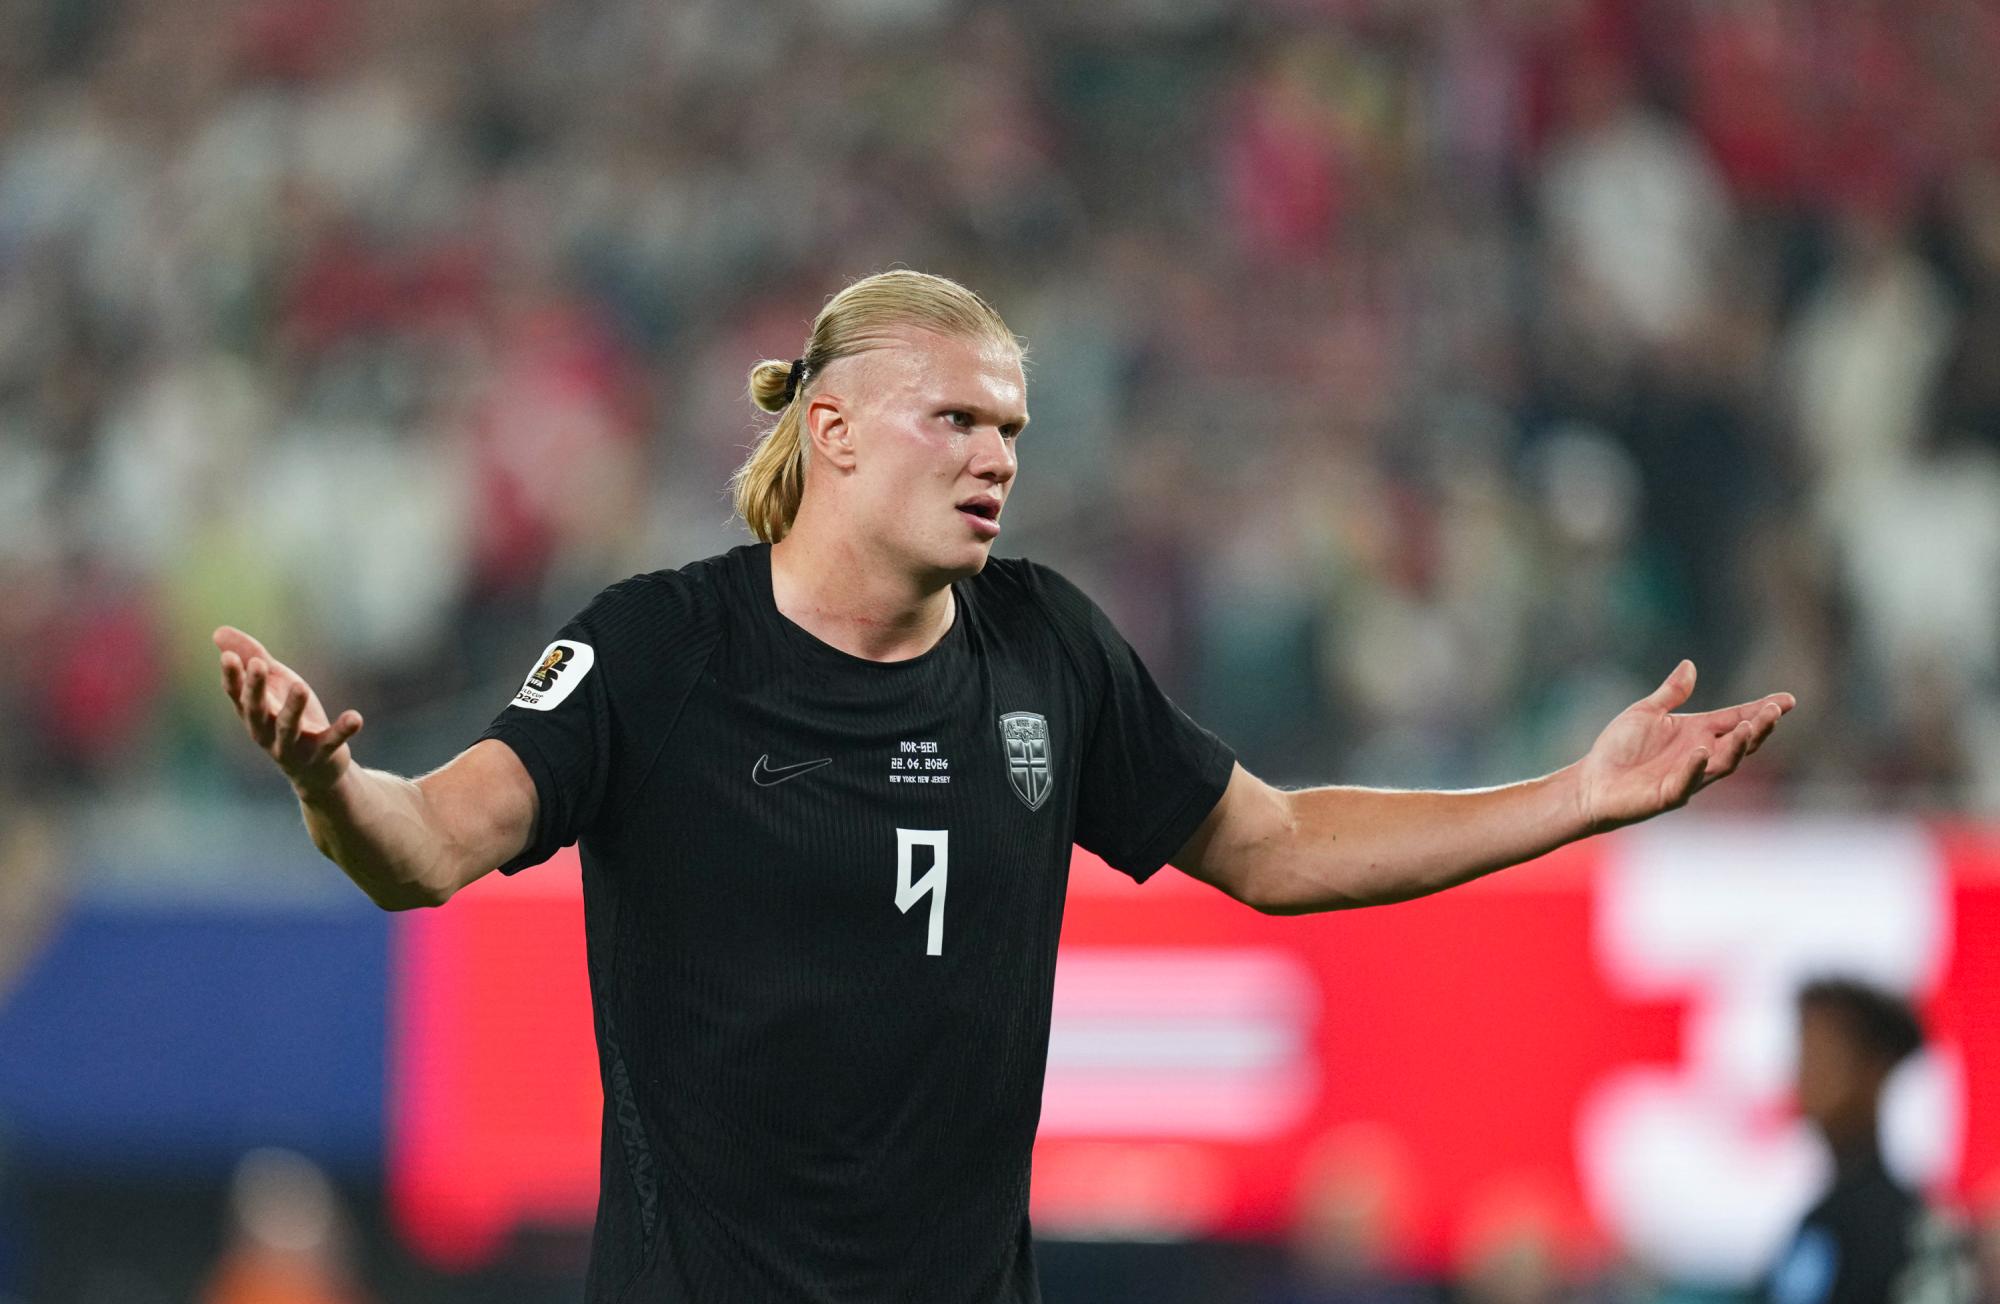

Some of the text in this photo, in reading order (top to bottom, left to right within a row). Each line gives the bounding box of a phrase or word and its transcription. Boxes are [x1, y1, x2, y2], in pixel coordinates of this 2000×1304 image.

[900, 740, 938, 753] NOR-SEN
[889, 774, 951, 784] NEW YORK NEW JERSEY
[894, 827, 949, 957] 9
